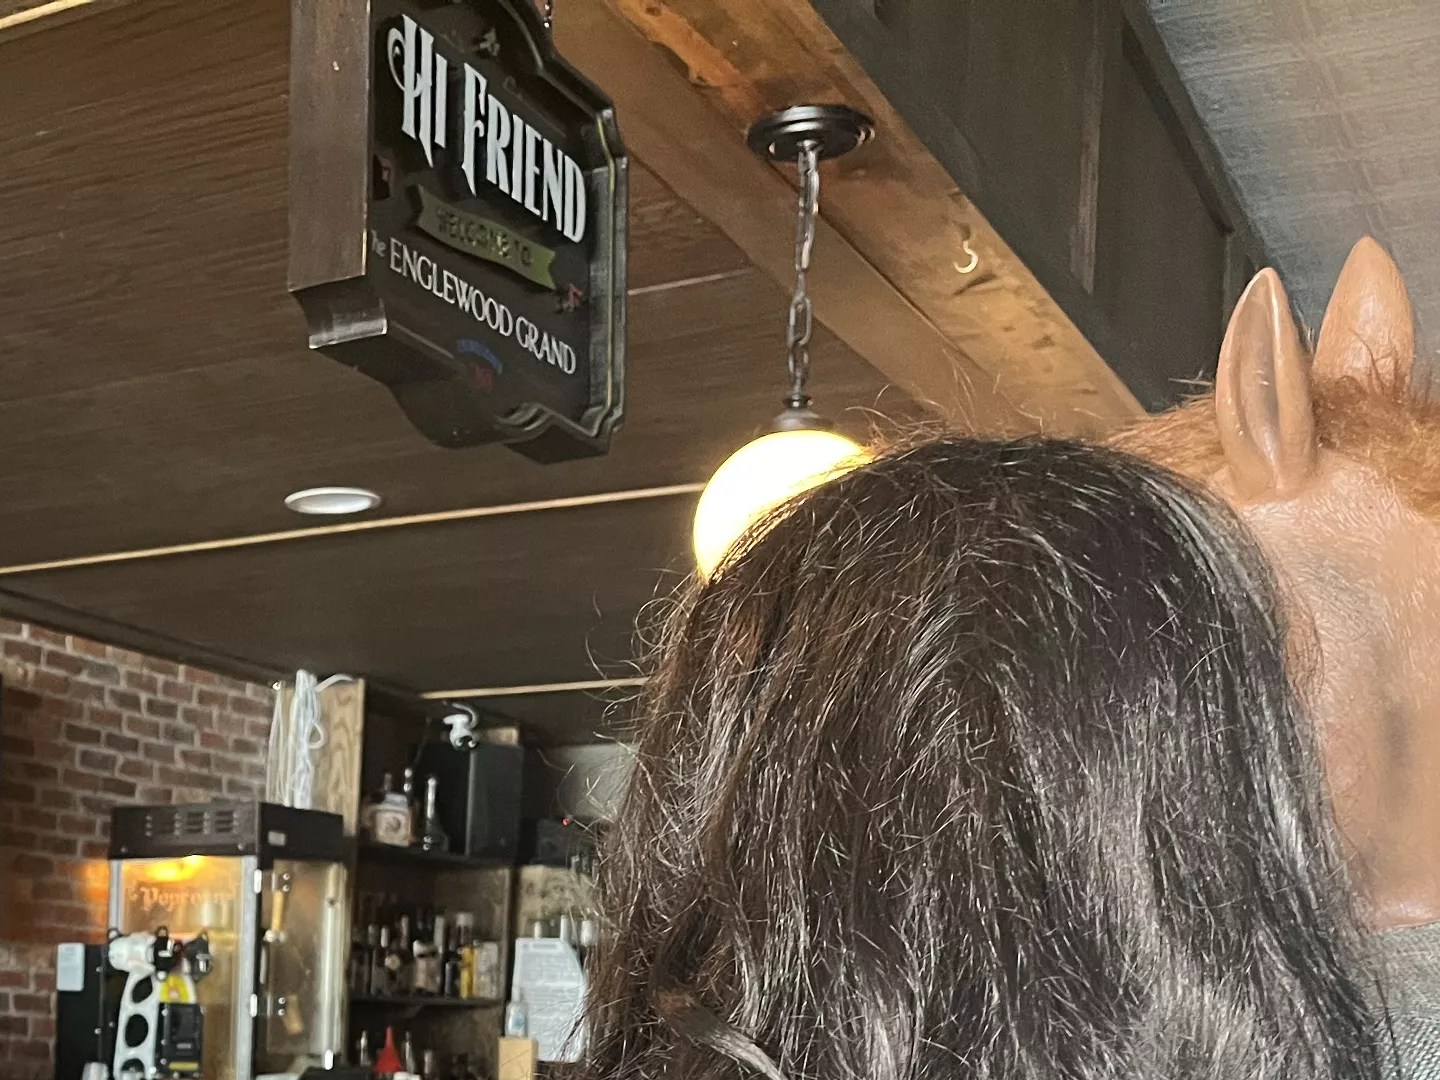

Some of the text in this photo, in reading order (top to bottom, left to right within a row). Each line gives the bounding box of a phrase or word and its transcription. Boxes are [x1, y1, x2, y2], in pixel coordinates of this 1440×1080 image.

[387, 13, 587, 244] HI FRIEND
[389, 236, 513, 338] ENGLEWOOD
[515, 315, 577, 376] GRAND
